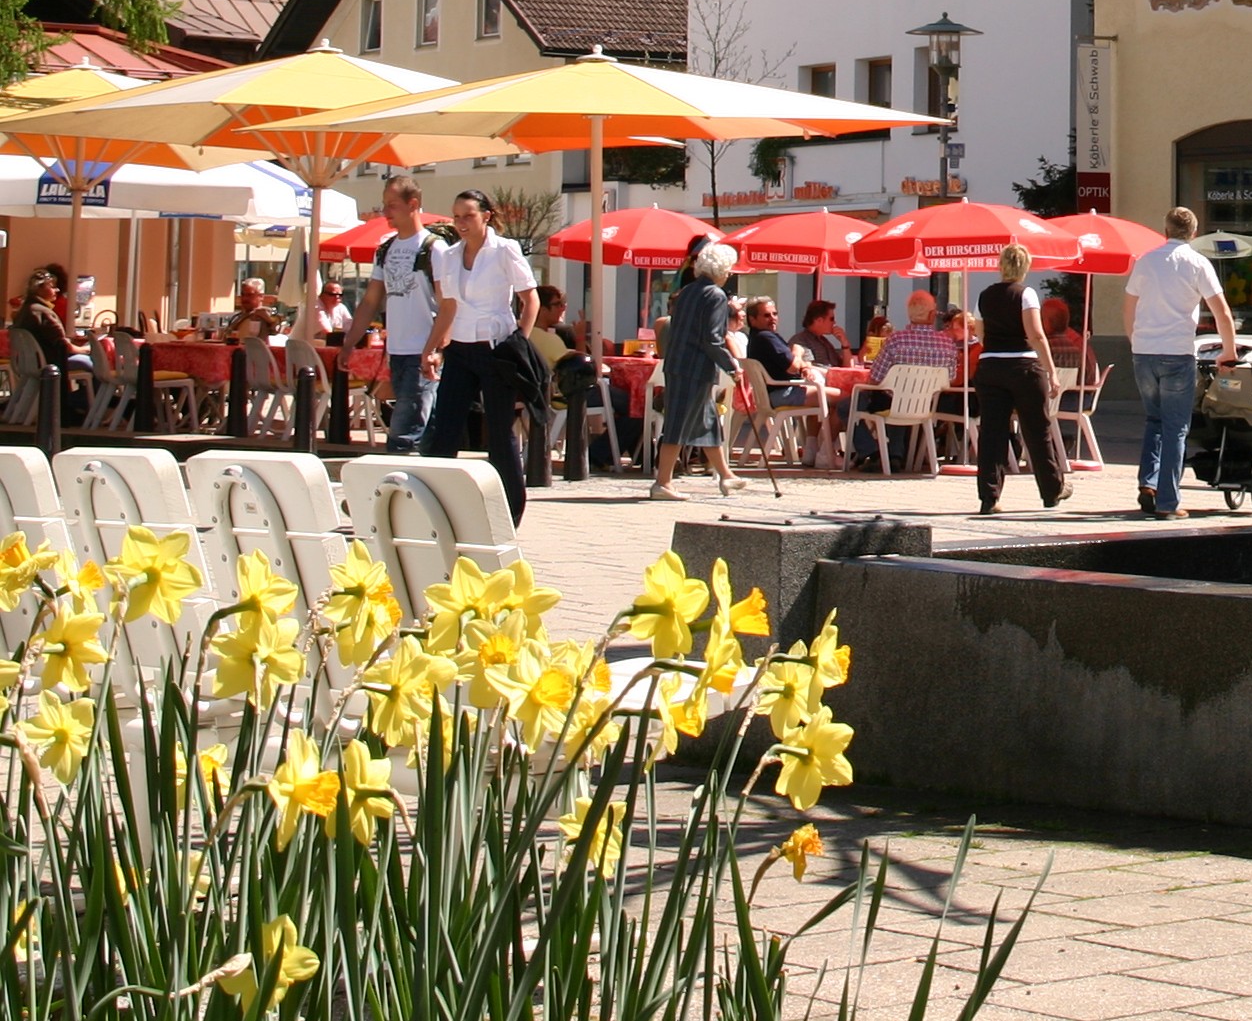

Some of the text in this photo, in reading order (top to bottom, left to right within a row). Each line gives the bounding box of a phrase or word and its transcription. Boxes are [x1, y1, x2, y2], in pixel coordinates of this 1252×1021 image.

[1089, 49, 1099, 169] Köberle & Schwab
[1078, 186, 1110, 198] OPTIK
[750, 251, 768, 261] DER
[925, 246, 944, 257] DER
[634, 256, 684, 266] DER HIRSCH
